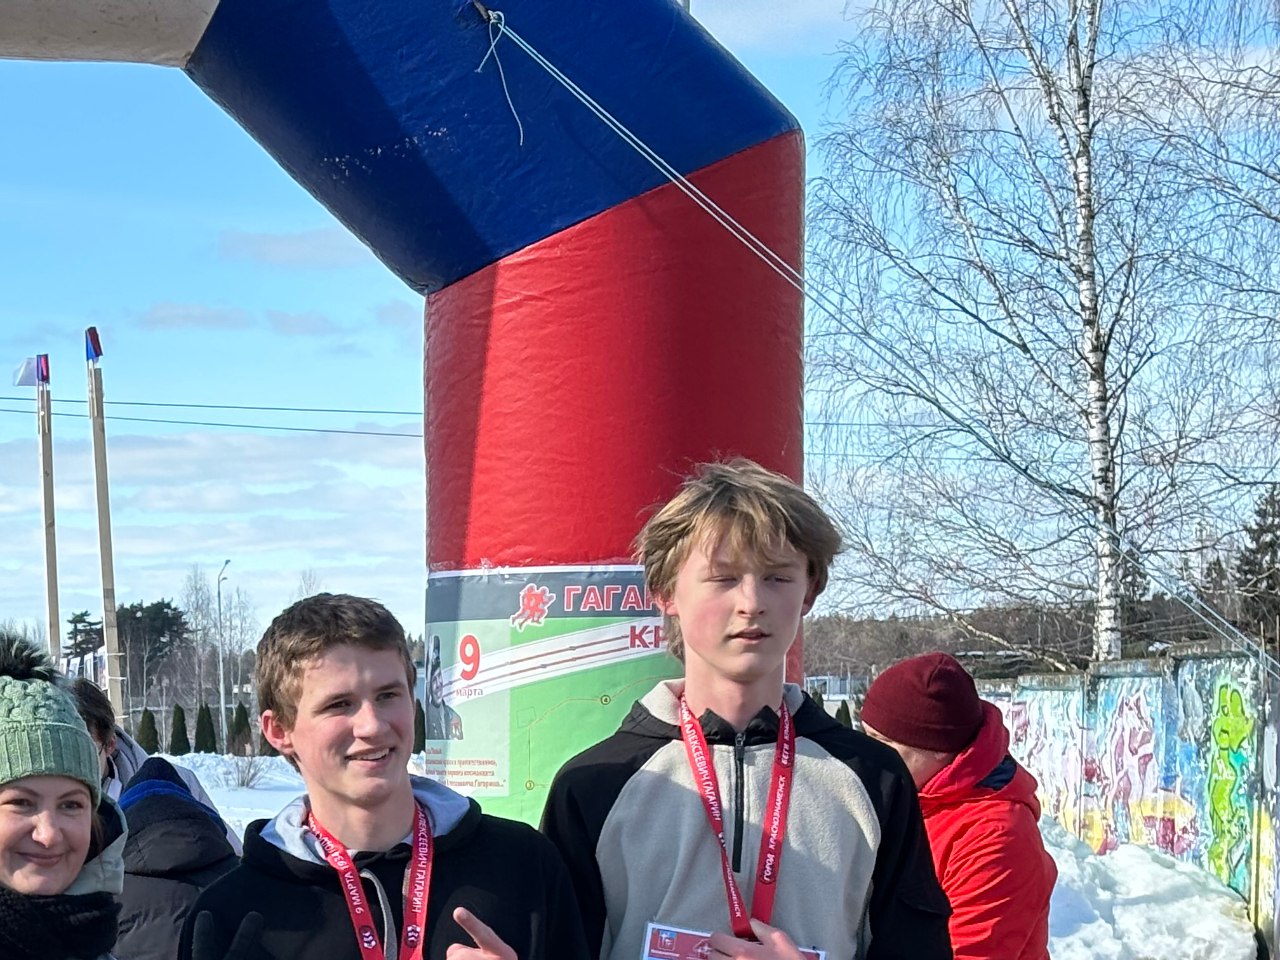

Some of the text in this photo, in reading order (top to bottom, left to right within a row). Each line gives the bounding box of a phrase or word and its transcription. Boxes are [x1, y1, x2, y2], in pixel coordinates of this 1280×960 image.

[455, 688, 483, 699] марта
[460, 634, 480, 681] 9
[684, 723, 710, 781] АЛЕКСЕЕВИЧ
[703, 781, 721, 821] ГАГАРИН
[412, 809, 428, 913] АЛЕКСЕЕВИЧ ГАГАРИН
[763, 775, 787, 882] ГОРОД КРАСНОЗНАМЕНСК
[345, 872, 363, 906] МАРТА
